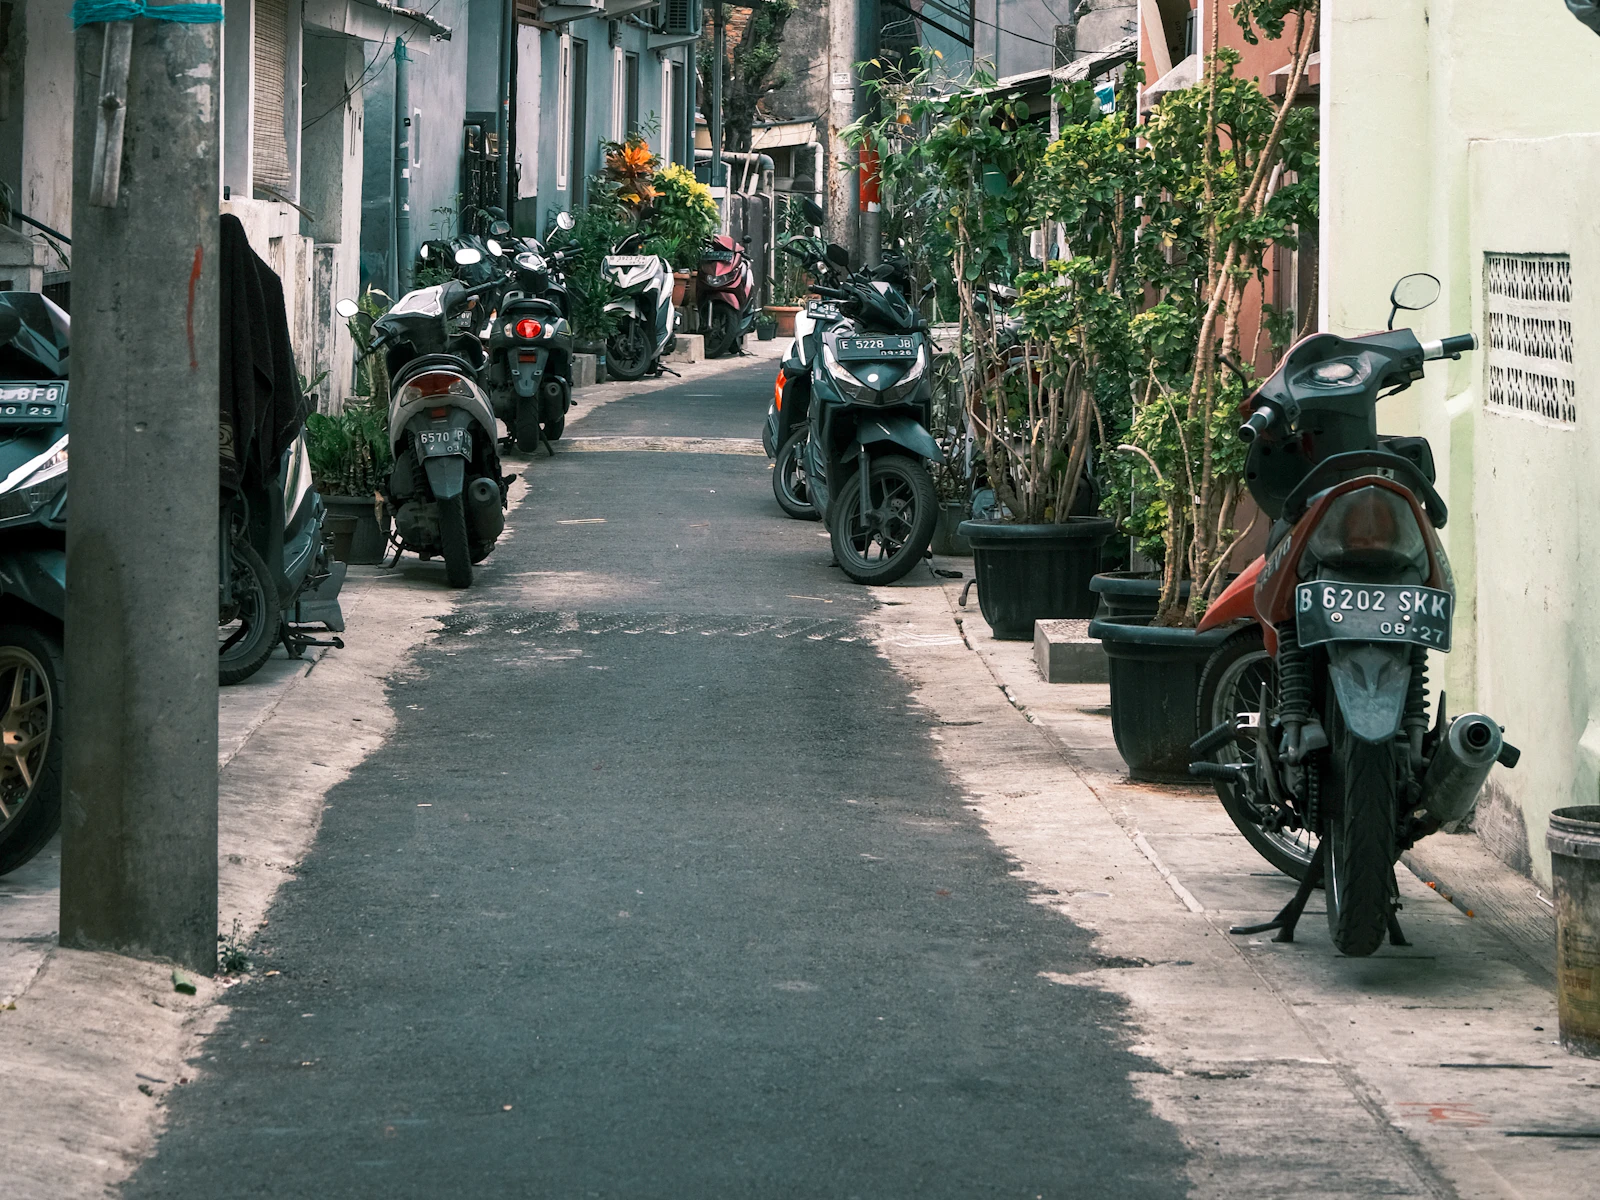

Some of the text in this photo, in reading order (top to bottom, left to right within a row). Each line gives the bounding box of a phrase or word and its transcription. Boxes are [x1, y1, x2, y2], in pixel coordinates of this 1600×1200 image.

[841, 339, 911, 350] E 5228 JB
[29, 407, 52, 416] 25
[420, 432, 450, 443] 6570
[1299, 586, 1446, 620] B 6202 SKK
